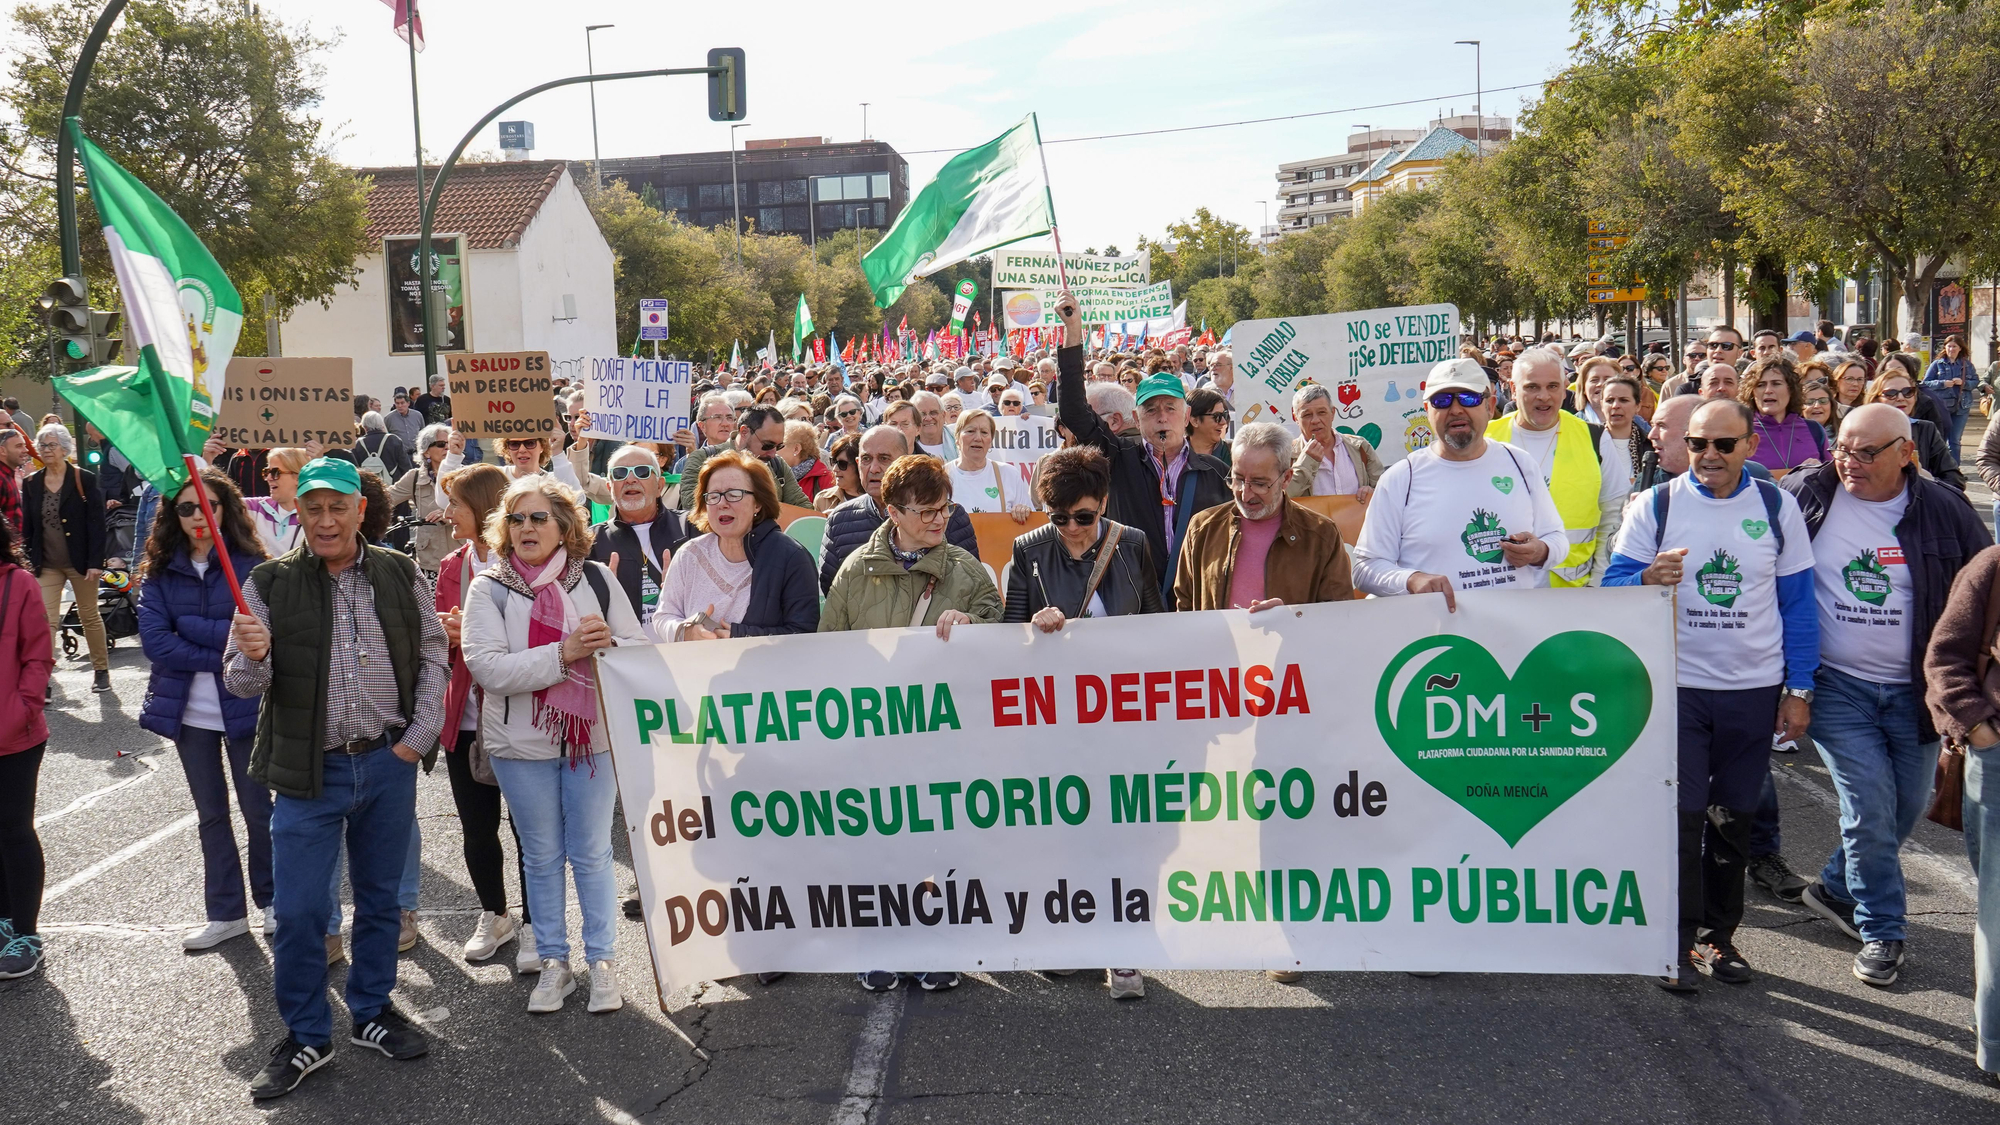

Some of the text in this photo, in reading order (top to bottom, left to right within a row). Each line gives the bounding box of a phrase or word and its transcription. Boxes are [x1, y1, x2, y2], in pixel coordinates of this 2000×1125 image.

[1065, 257, 1110, 272] NÚÑEZ
[1114, 260, 1139, 272] POR
[997, 272, 1026, 284] UNA
[1046, 288, 1109, 298] PLAFORMA
[1125, 284, 1168, 298] DEFENSA
[955, 303, 968, 314] GT
[1045, 305, 1172, 324] FENÁN NÚÑEZ
[1347, 314, 1450, 343] NO se VENDE
[1238, 321, 1296, 378] La SANIDAD
[448, 359, 466, 374] LA
[470, 358, 520, 372] SALUD
[526, 356, 544, 370] ES
[592, 358, 624, 381] DOÑA
[633, 360, 689, 384] MENCIA
[1265, 348, 1310, 394] PÚBLICA
[224, 387, 350, 402] ISIONISTAS
[450, 378, 551, 394] UN DERECHO
[600, 385, 669, 409] POR LA
[488, 400, 515, 414] NO
[457, 418, 554, 433] UN NEGOCIO
[634, 664, 1310, 744] PLATAFORMA EN DEFENSA
[1570, 692, 1598, 737] S
[1418, 745, 1608, 760] PLATAFORMA CIUDADANA POR LA SANIDAD PÚBLICA
[1466, 783, 1548, 798] DOÑA MENCÍA
[650, 760, 1388, 847] del CONSULTORIO MÉDICO de
[665, 854, 1648, 946] DOÑA MENCÍA y de la SANIDAD PÚBLICA
